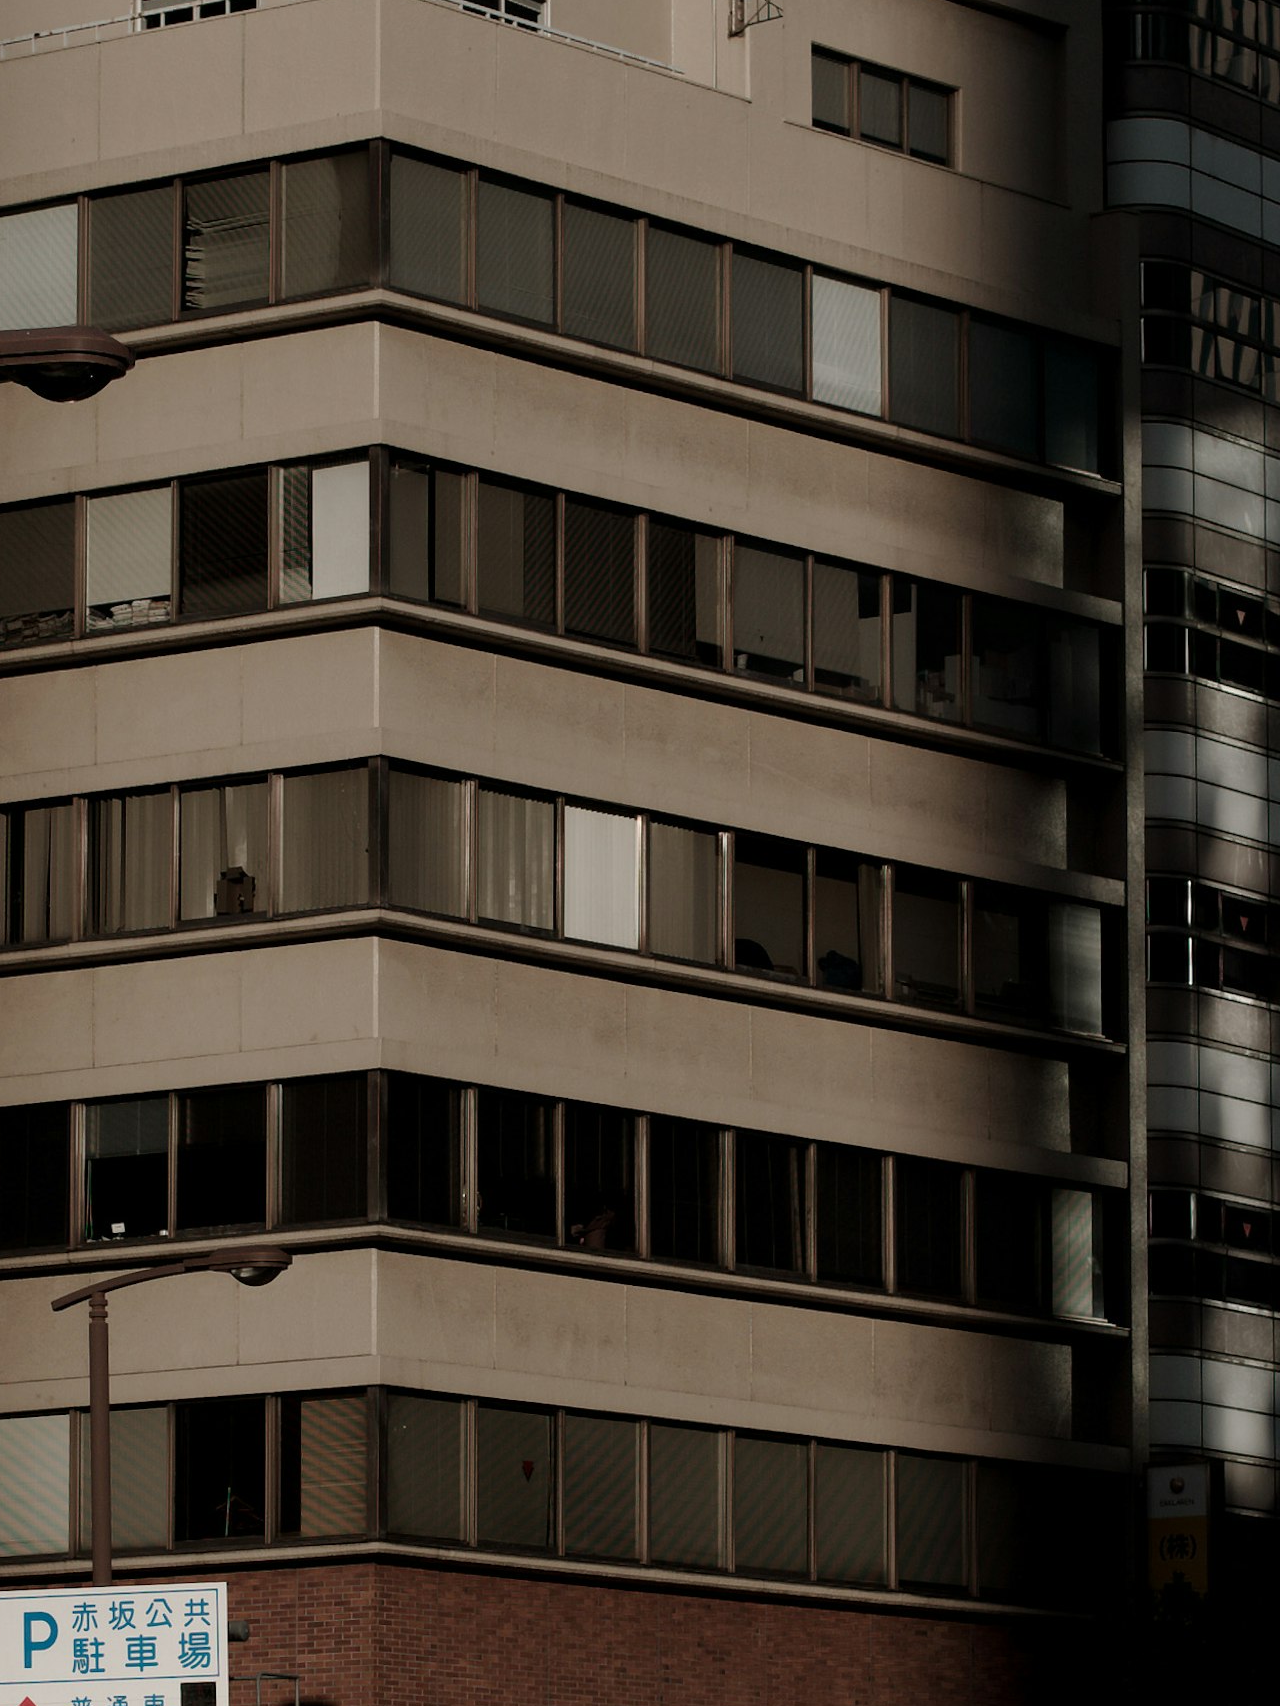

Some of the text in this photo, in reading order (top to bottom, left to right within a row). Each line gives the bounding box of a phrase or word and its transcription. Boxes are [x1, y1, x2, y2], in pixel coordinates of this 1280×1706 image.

[71, 1598, 211, 1633] 赤坂公共
[23, 1611, 59, 1669] P
[72, 1632, 212, 1675] 駐車場
